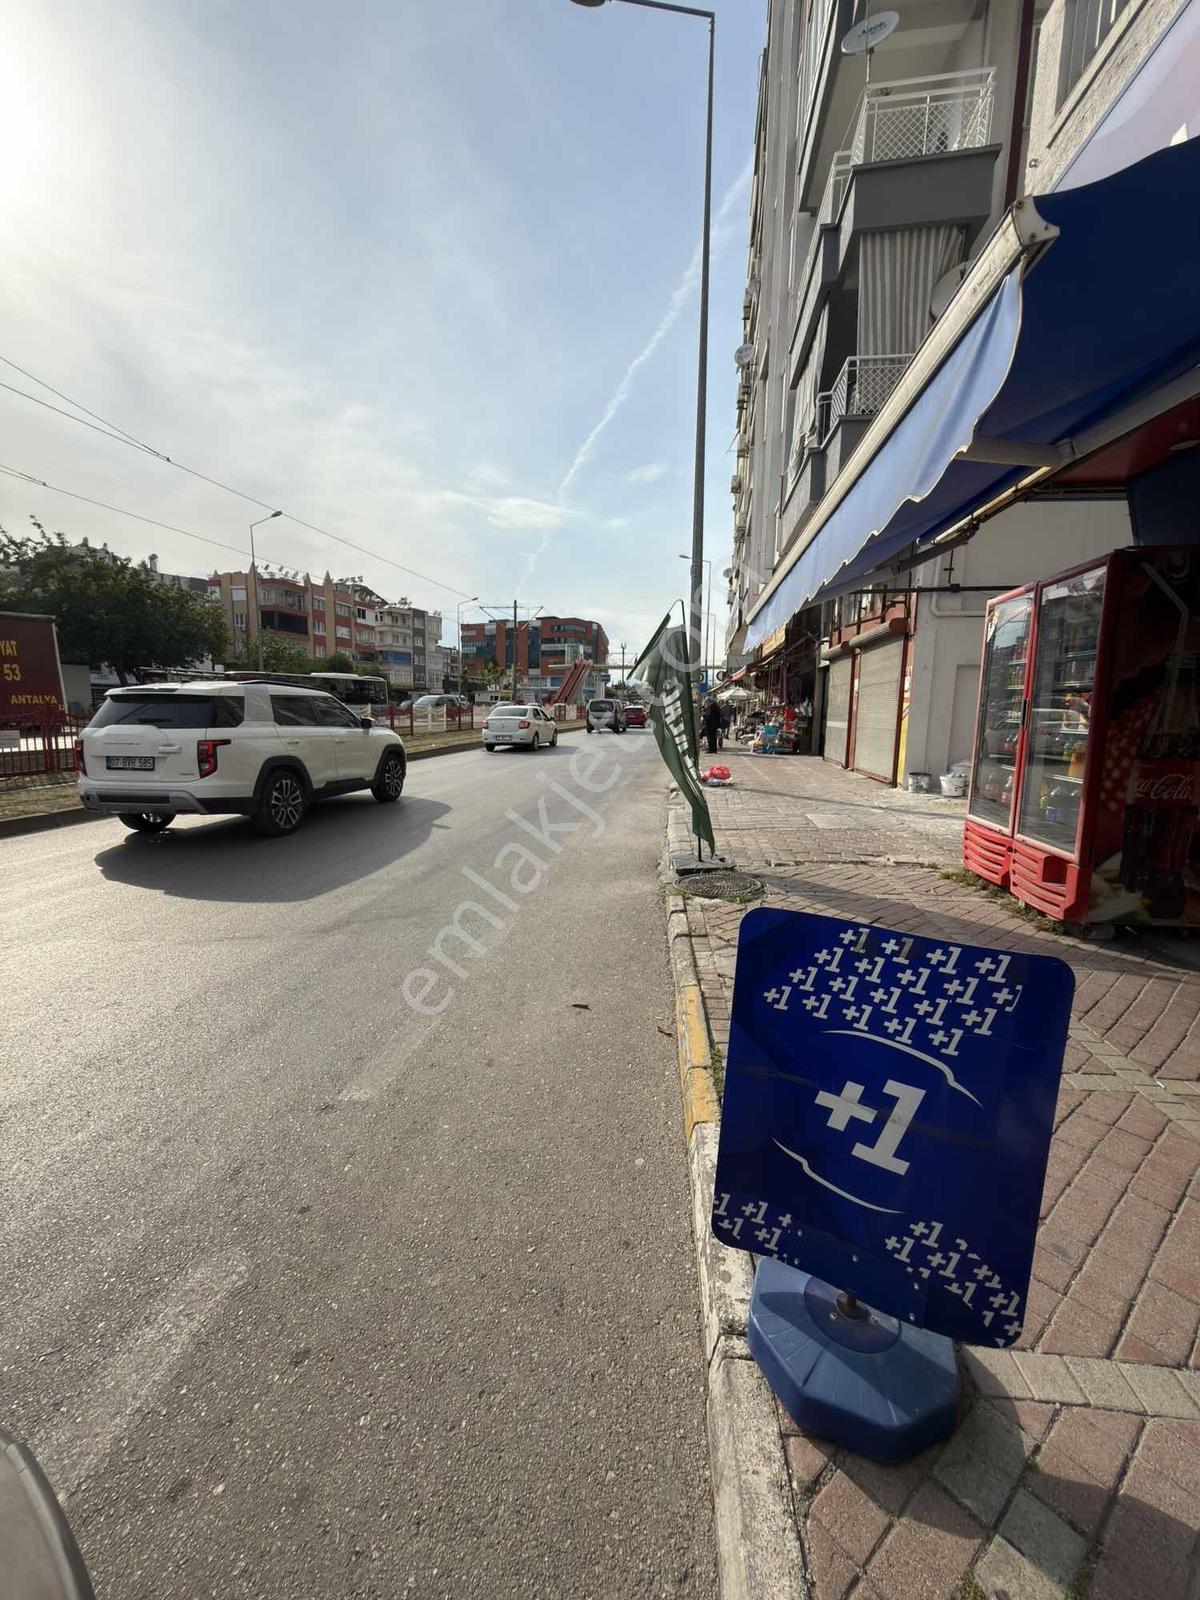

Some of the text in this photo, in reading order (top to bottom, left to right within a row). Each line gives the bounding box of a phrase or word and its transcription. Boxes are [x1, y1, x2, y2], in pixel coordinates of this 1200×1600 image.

[3, 664, 21, 681] 53
[11, 694, 57, 705] ANTALYA
[814, 947, 844, 973] +1
[854, 957, 885, 984] +1
[896, 967, 931, 996] +1
[943, 977, 980, 1006] +1
[839, 928, 1012, 984] +1 +1 +1 +1
[763, 985, 964, 1056] +1 +1 +1 +1 +1
[789, 966, 998, 1036] +1 +1 +1 +1 +1
[814, 1079, 927, 1176] +1
[741, 1201, 769, 1225] +1
[754, 1227, 782, 1251] +1
[909, 1221, 944, 1249] +1
[884, 1236, 915, 1263] +1
[926, 1252, 961, 1279] +1
